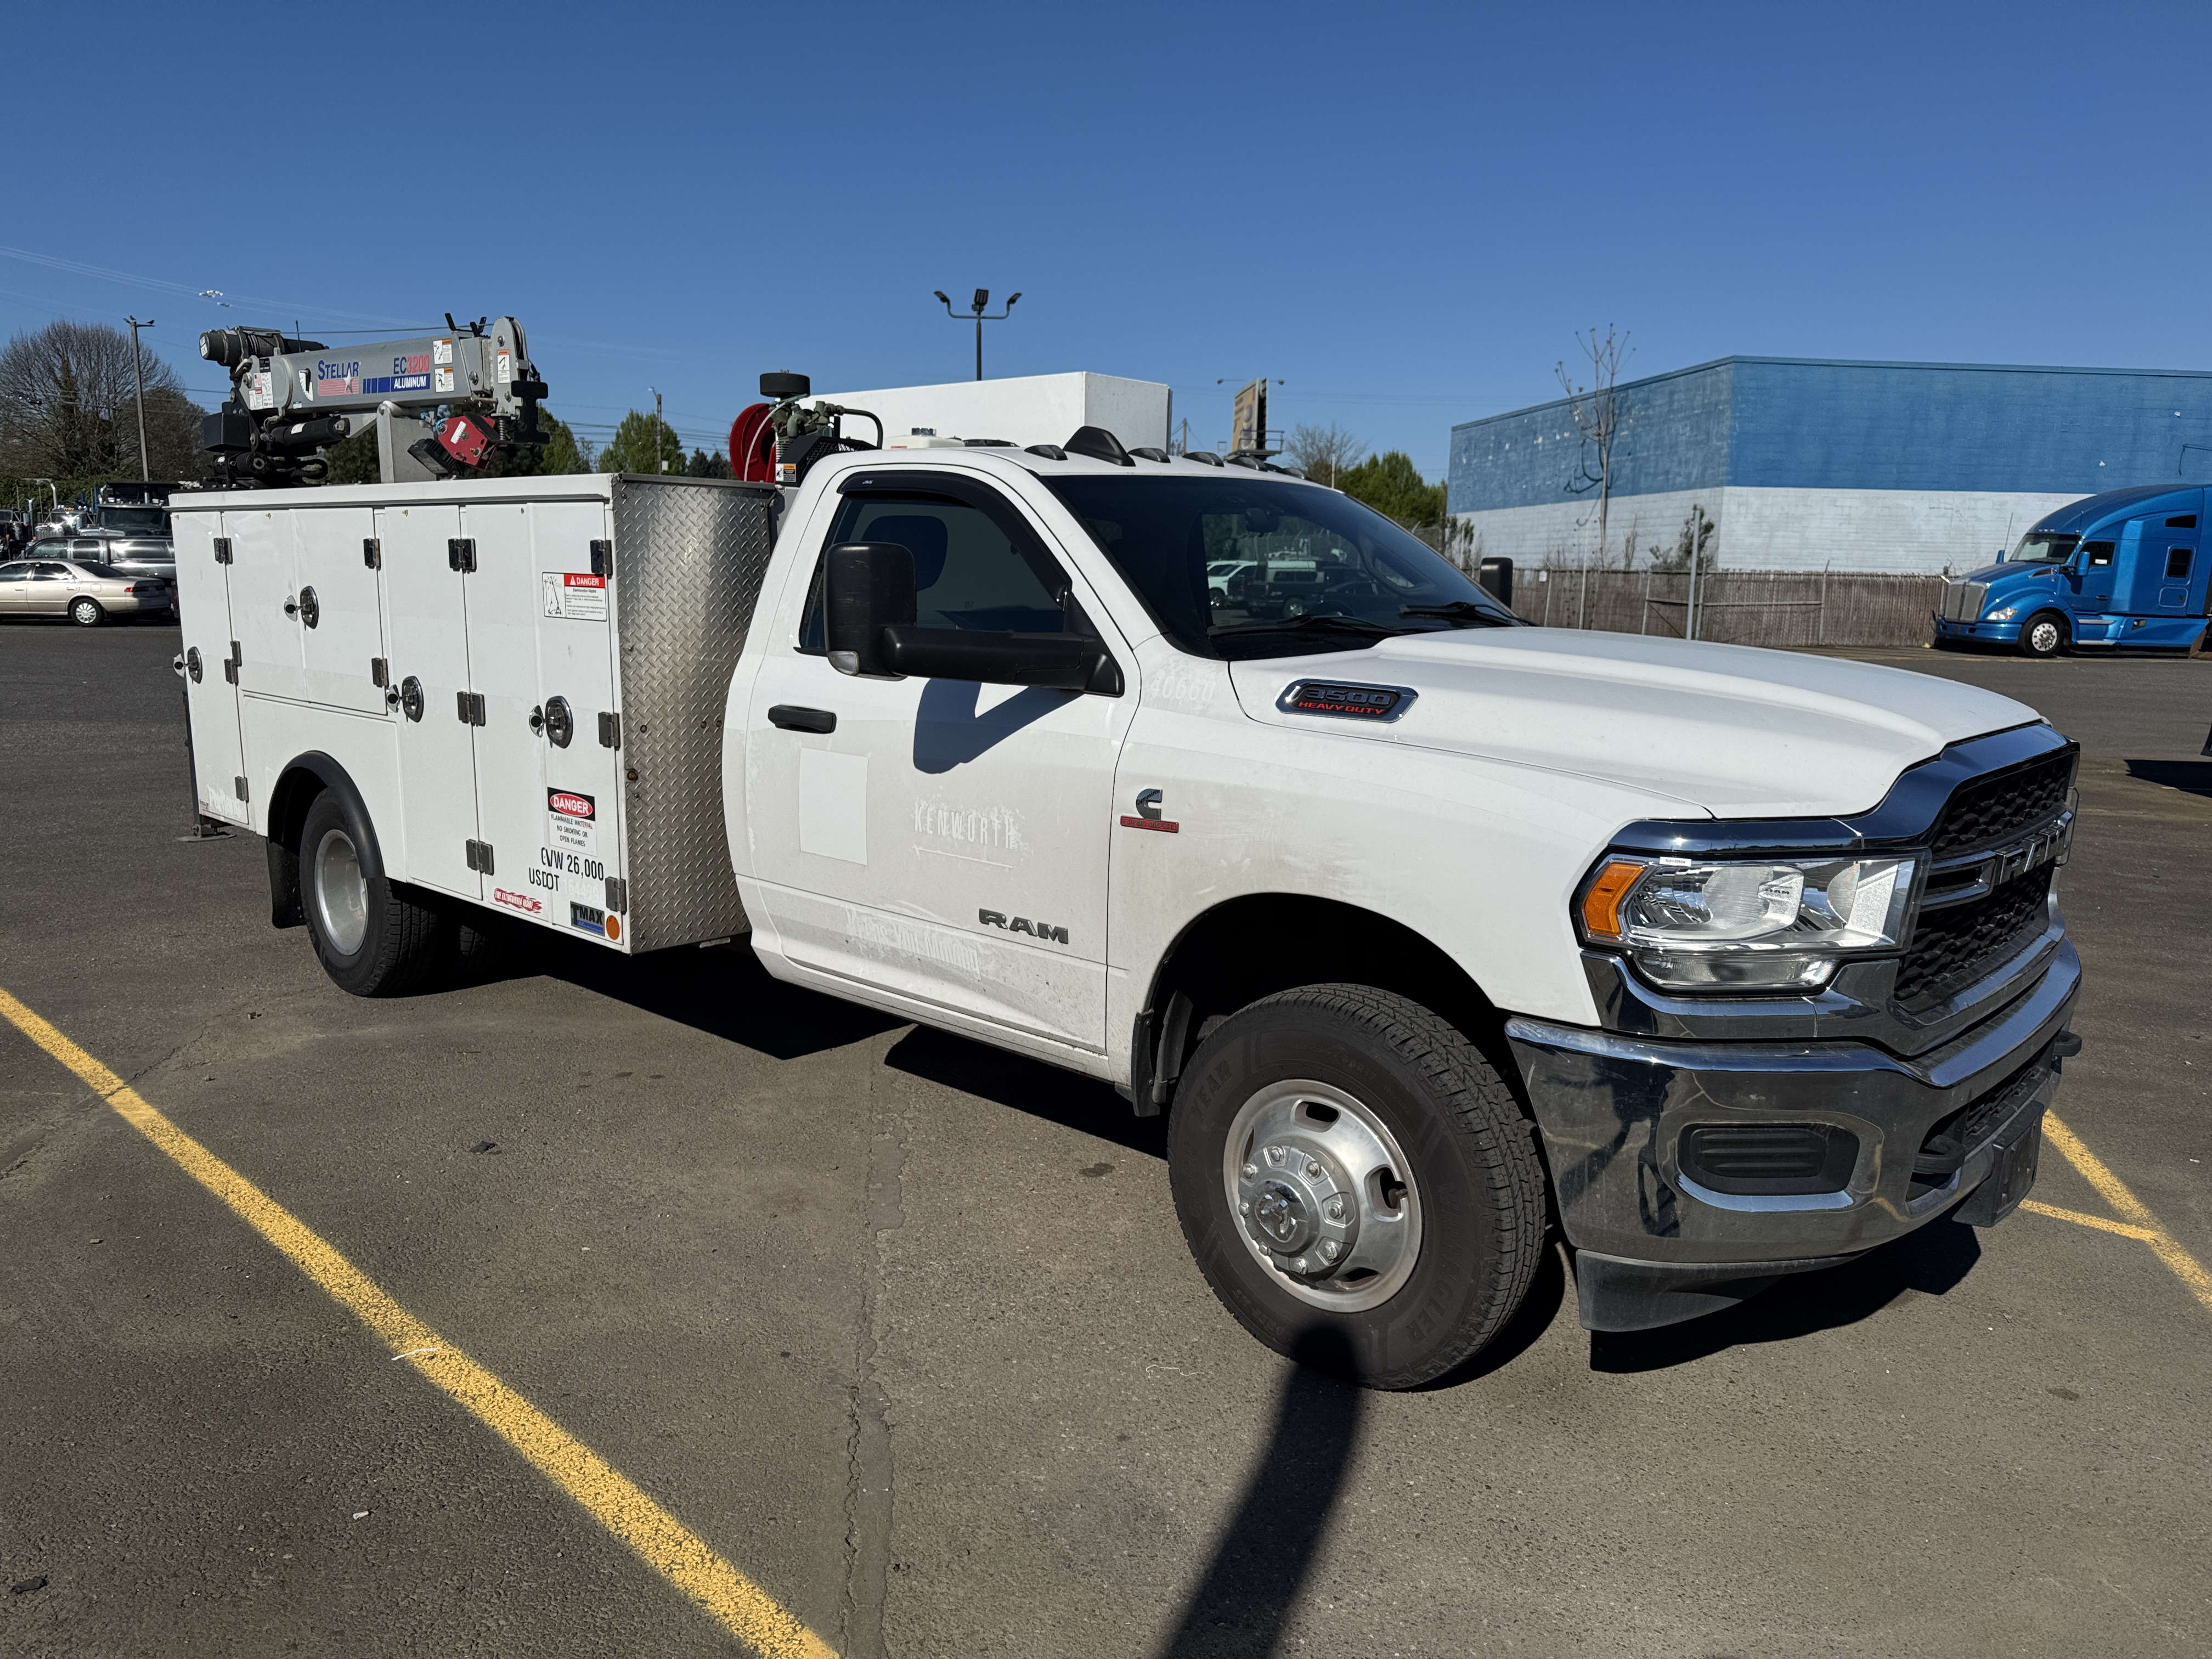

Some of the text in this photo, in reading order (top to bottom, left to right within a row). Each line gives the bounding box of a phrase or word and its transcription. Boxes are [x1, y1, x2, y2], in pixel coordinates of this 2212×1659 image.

[318, 360, 359, 380] STELLAR
[393, 354, 430, 374] EC3200
[393, 375, 426, 389] ALUMINUM
[576, 577, 600, 586] DANGER
[1305, 689, 1391, 706] 3500
[1298, 701, 1386, 714] HEAVY DUTY
[554, 796, 589, 814] DANGER
[1136, 790, 1160, 805] Cummins
[551, 814, 593, 830] FLAMMABLE MATERIAL
[914, 801, 1015, 850] KENWORTH
[1148, 821, 1177, 830] DIESEL
[563, 826, 581, 837] SMOKING
[560, 835, 585, 847] OPEN FLAMES
[1994, 824, 2064, 885] RAM
[567, 854, 604, 881] 26,000
[528, 867, 560, 891] USDOT
[571, 903, 603, 925] TMAX
[979, 908, 1069, 944] RAM
